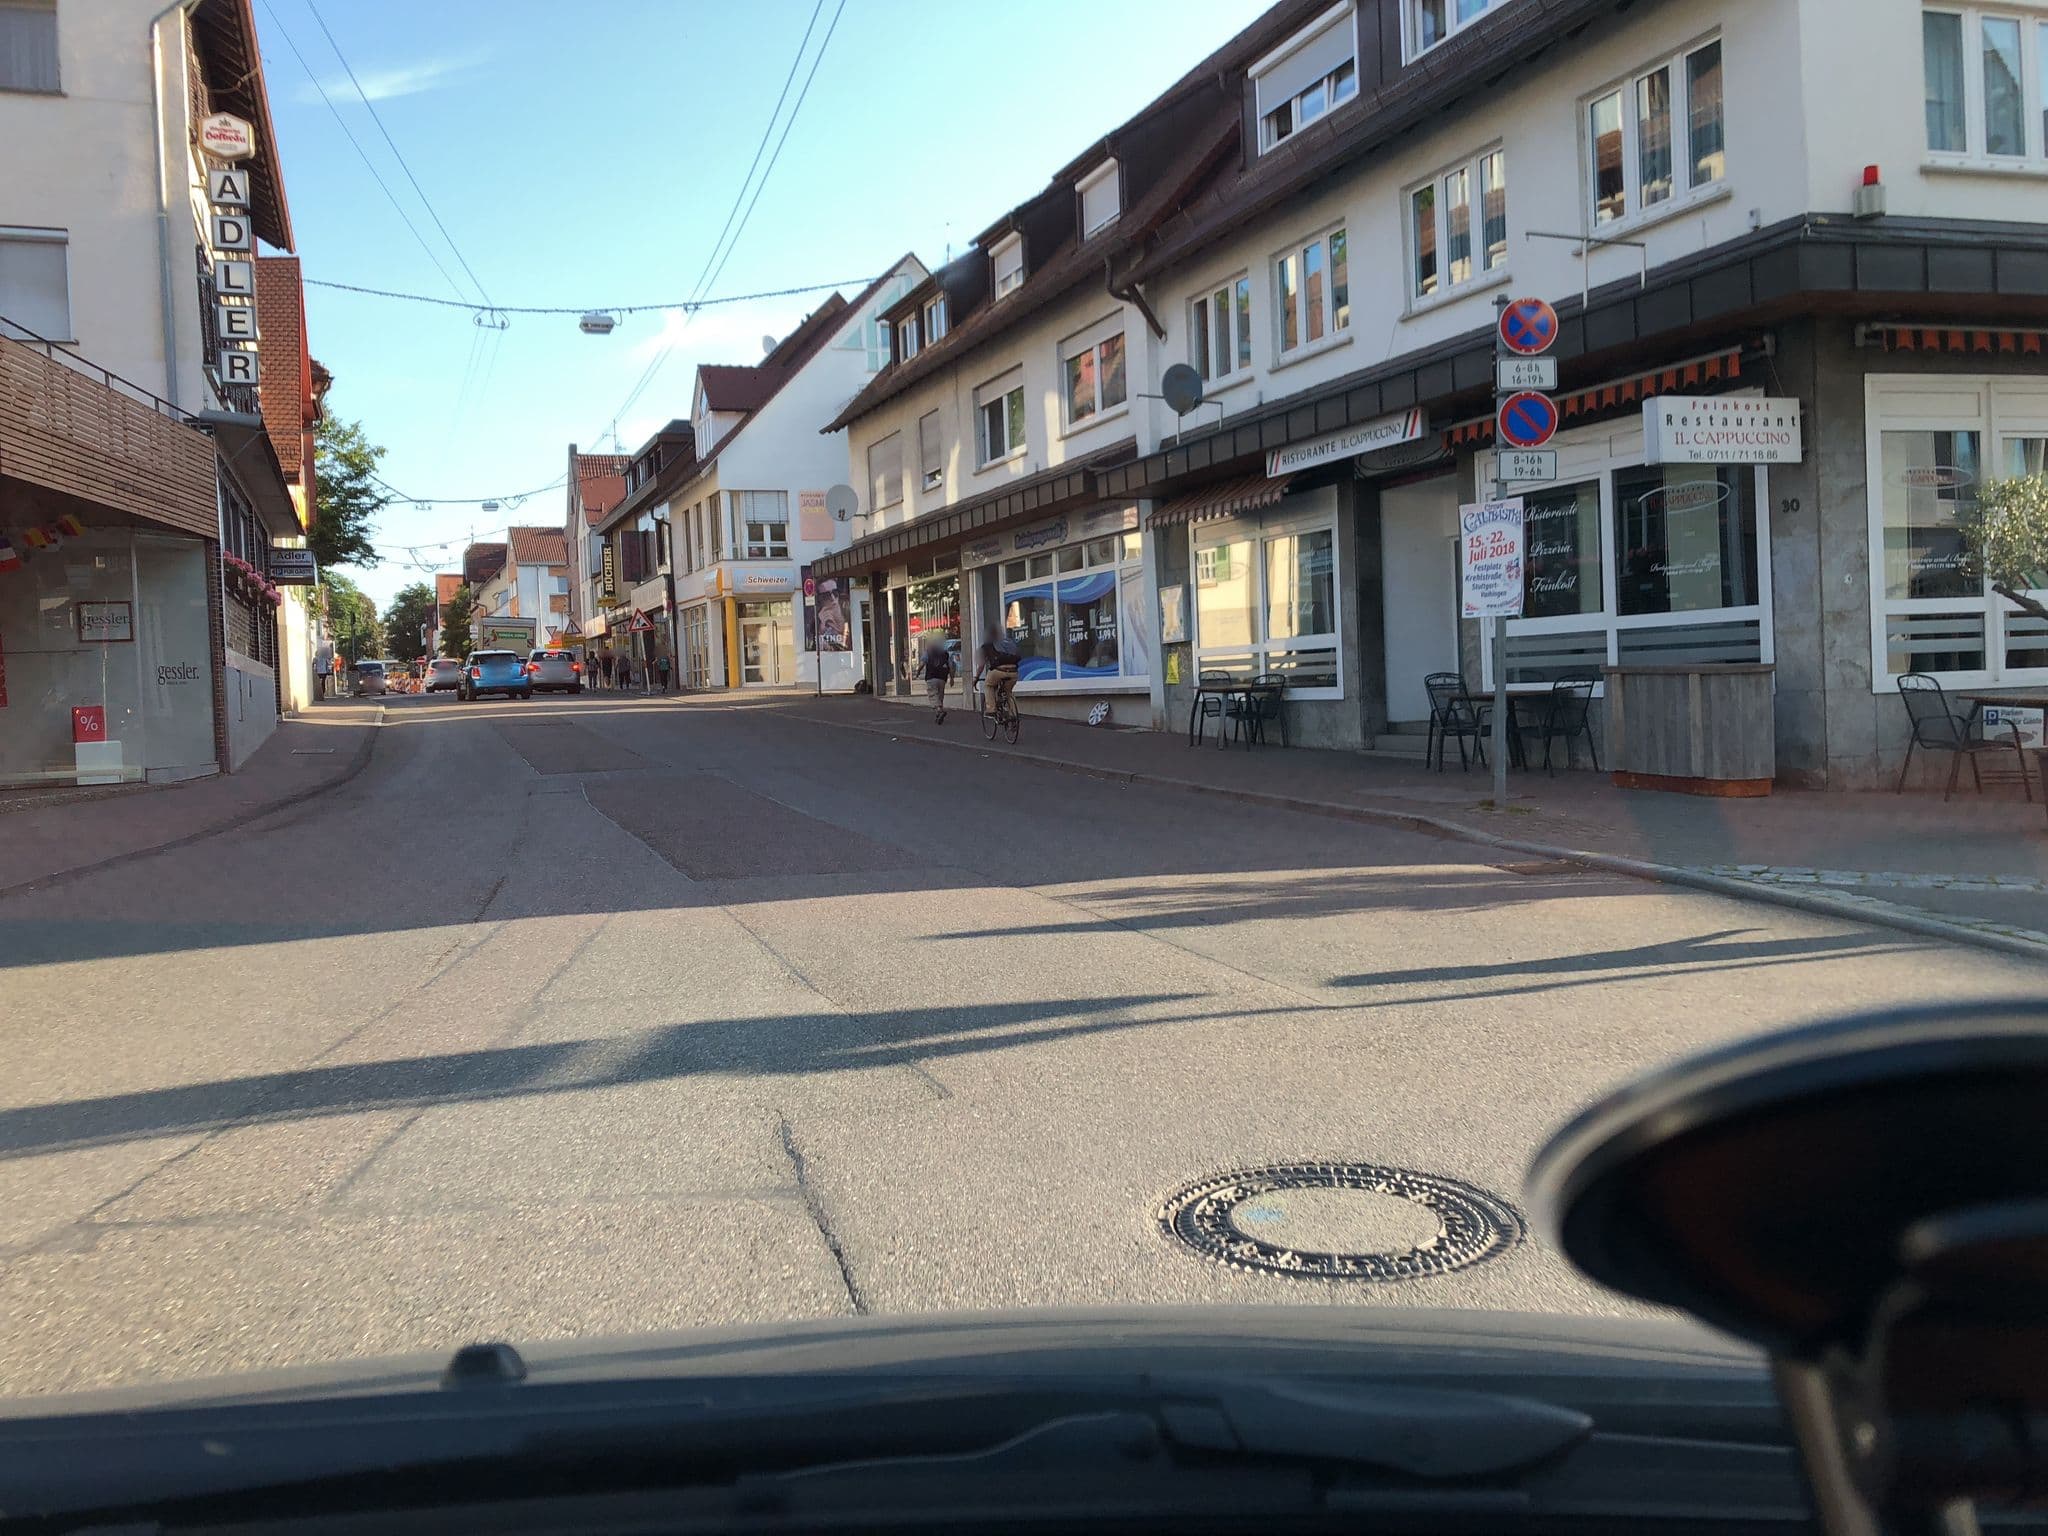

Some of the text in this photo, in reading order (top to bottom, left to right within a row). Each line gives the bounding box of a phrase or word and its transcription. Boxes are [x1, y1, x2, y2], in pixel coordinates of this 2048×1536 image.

[217, 175, 251, 380] ADLER
[1691, 400, 1771, 411] Feinkost
[1666, 413, 1797, 427] Restaurant
[1281, 440, 1337, 467] RISTORANTE
[1350, 423, 1401, 448] CAPPUCCINO
[1693, 431, 1791, 446] CAPPUCCINO
[1523, 501, 1579, 522] Ristorante
[277, 551, 307, 561] Adler
[1488, 540, 1515, 558] 2018
[747, 575, 789, 584] Schweizer
[1529, 570, 1577, 593] Feinkost
[80, 715, 98, 731] %
